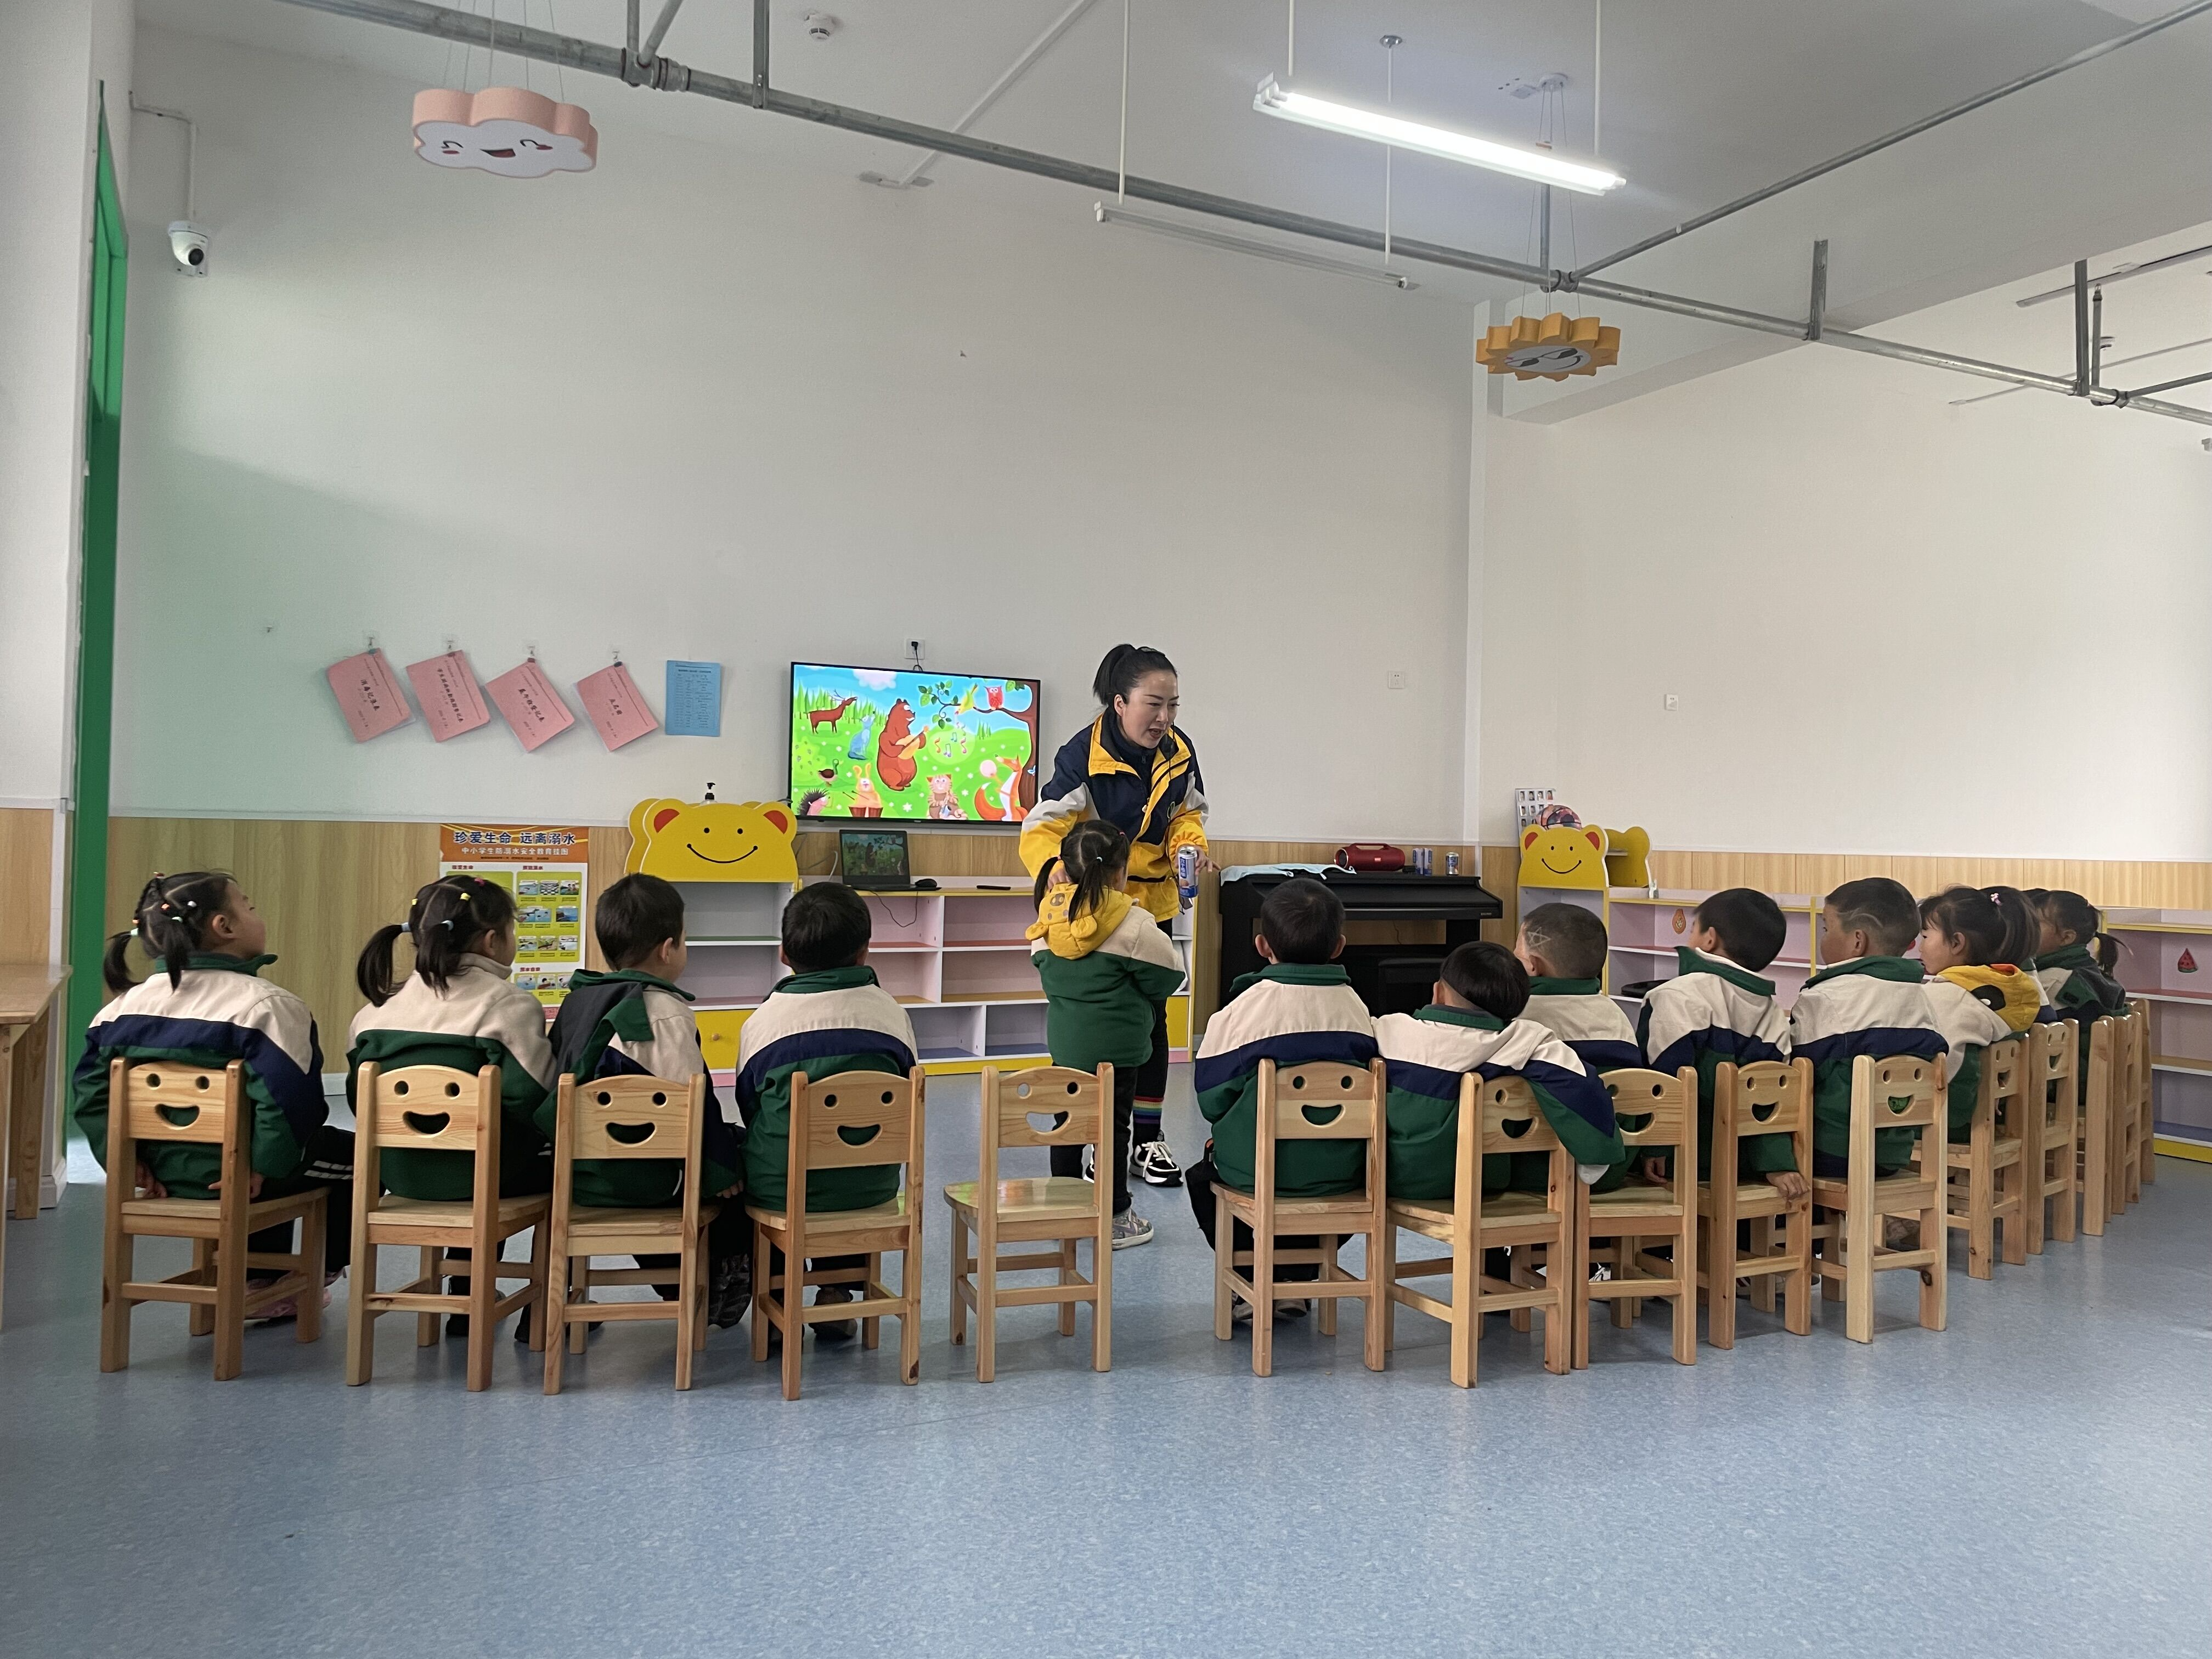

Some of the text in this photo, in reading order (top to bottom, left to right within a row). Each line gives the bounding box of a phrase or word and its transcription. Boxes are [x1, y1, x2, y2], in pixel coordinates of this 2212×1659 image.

[454, 831, 576, 845] 珍爱生命 远离溺水
[461, 847, 569, 855] 中小学生防溺水安全教育挂图
